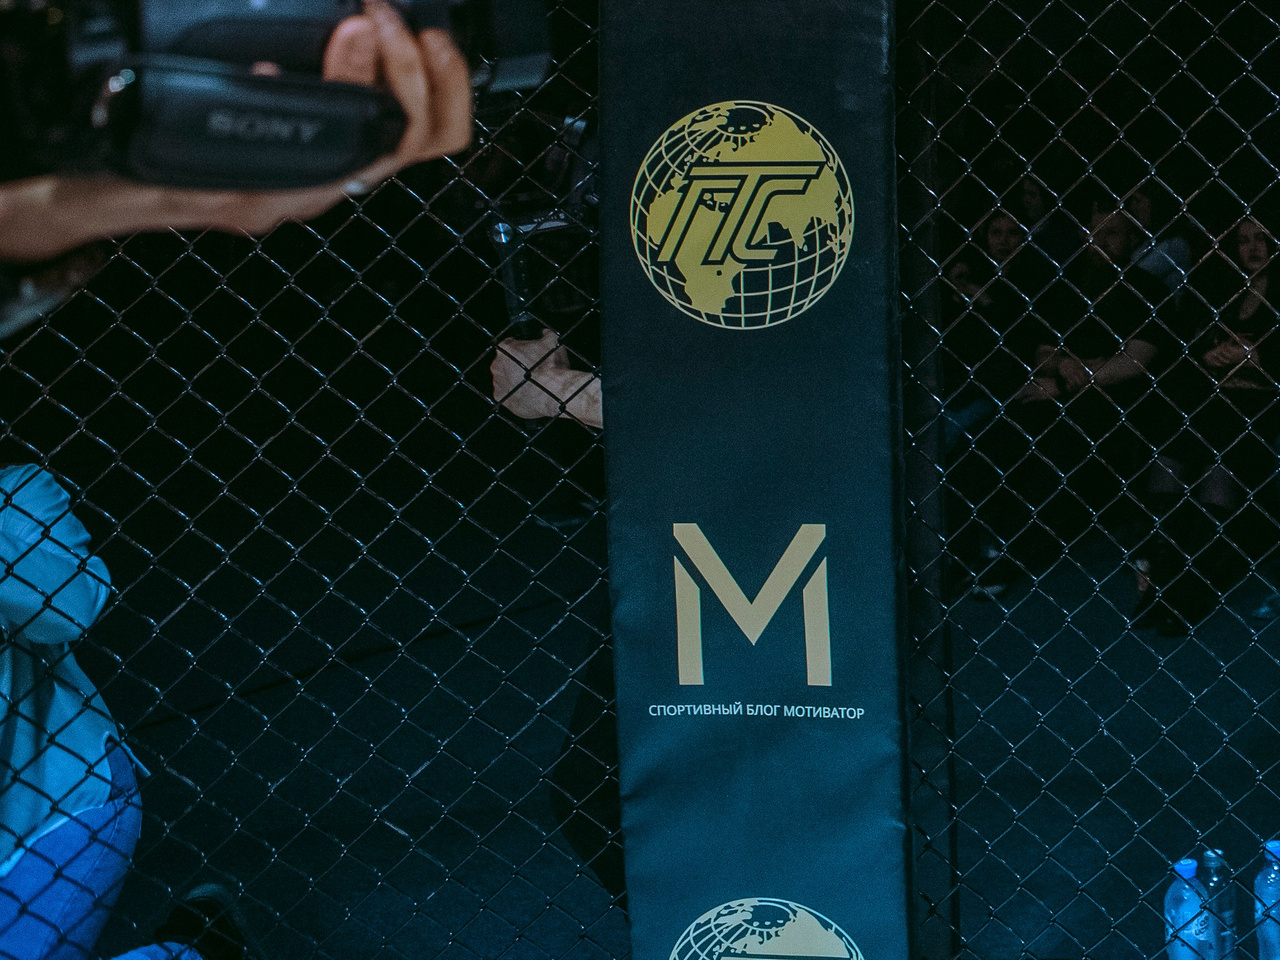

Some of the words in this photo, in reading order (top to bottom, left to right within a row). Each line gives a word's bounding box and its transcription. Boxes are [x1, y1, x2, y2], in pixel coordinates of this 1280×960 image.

[649, 702, 743, 716] СПОРТИВНЫЙ
[746, 704, 780, 716] БЛОГ
[783, 705, 865, 719] МОТИВАТОР
